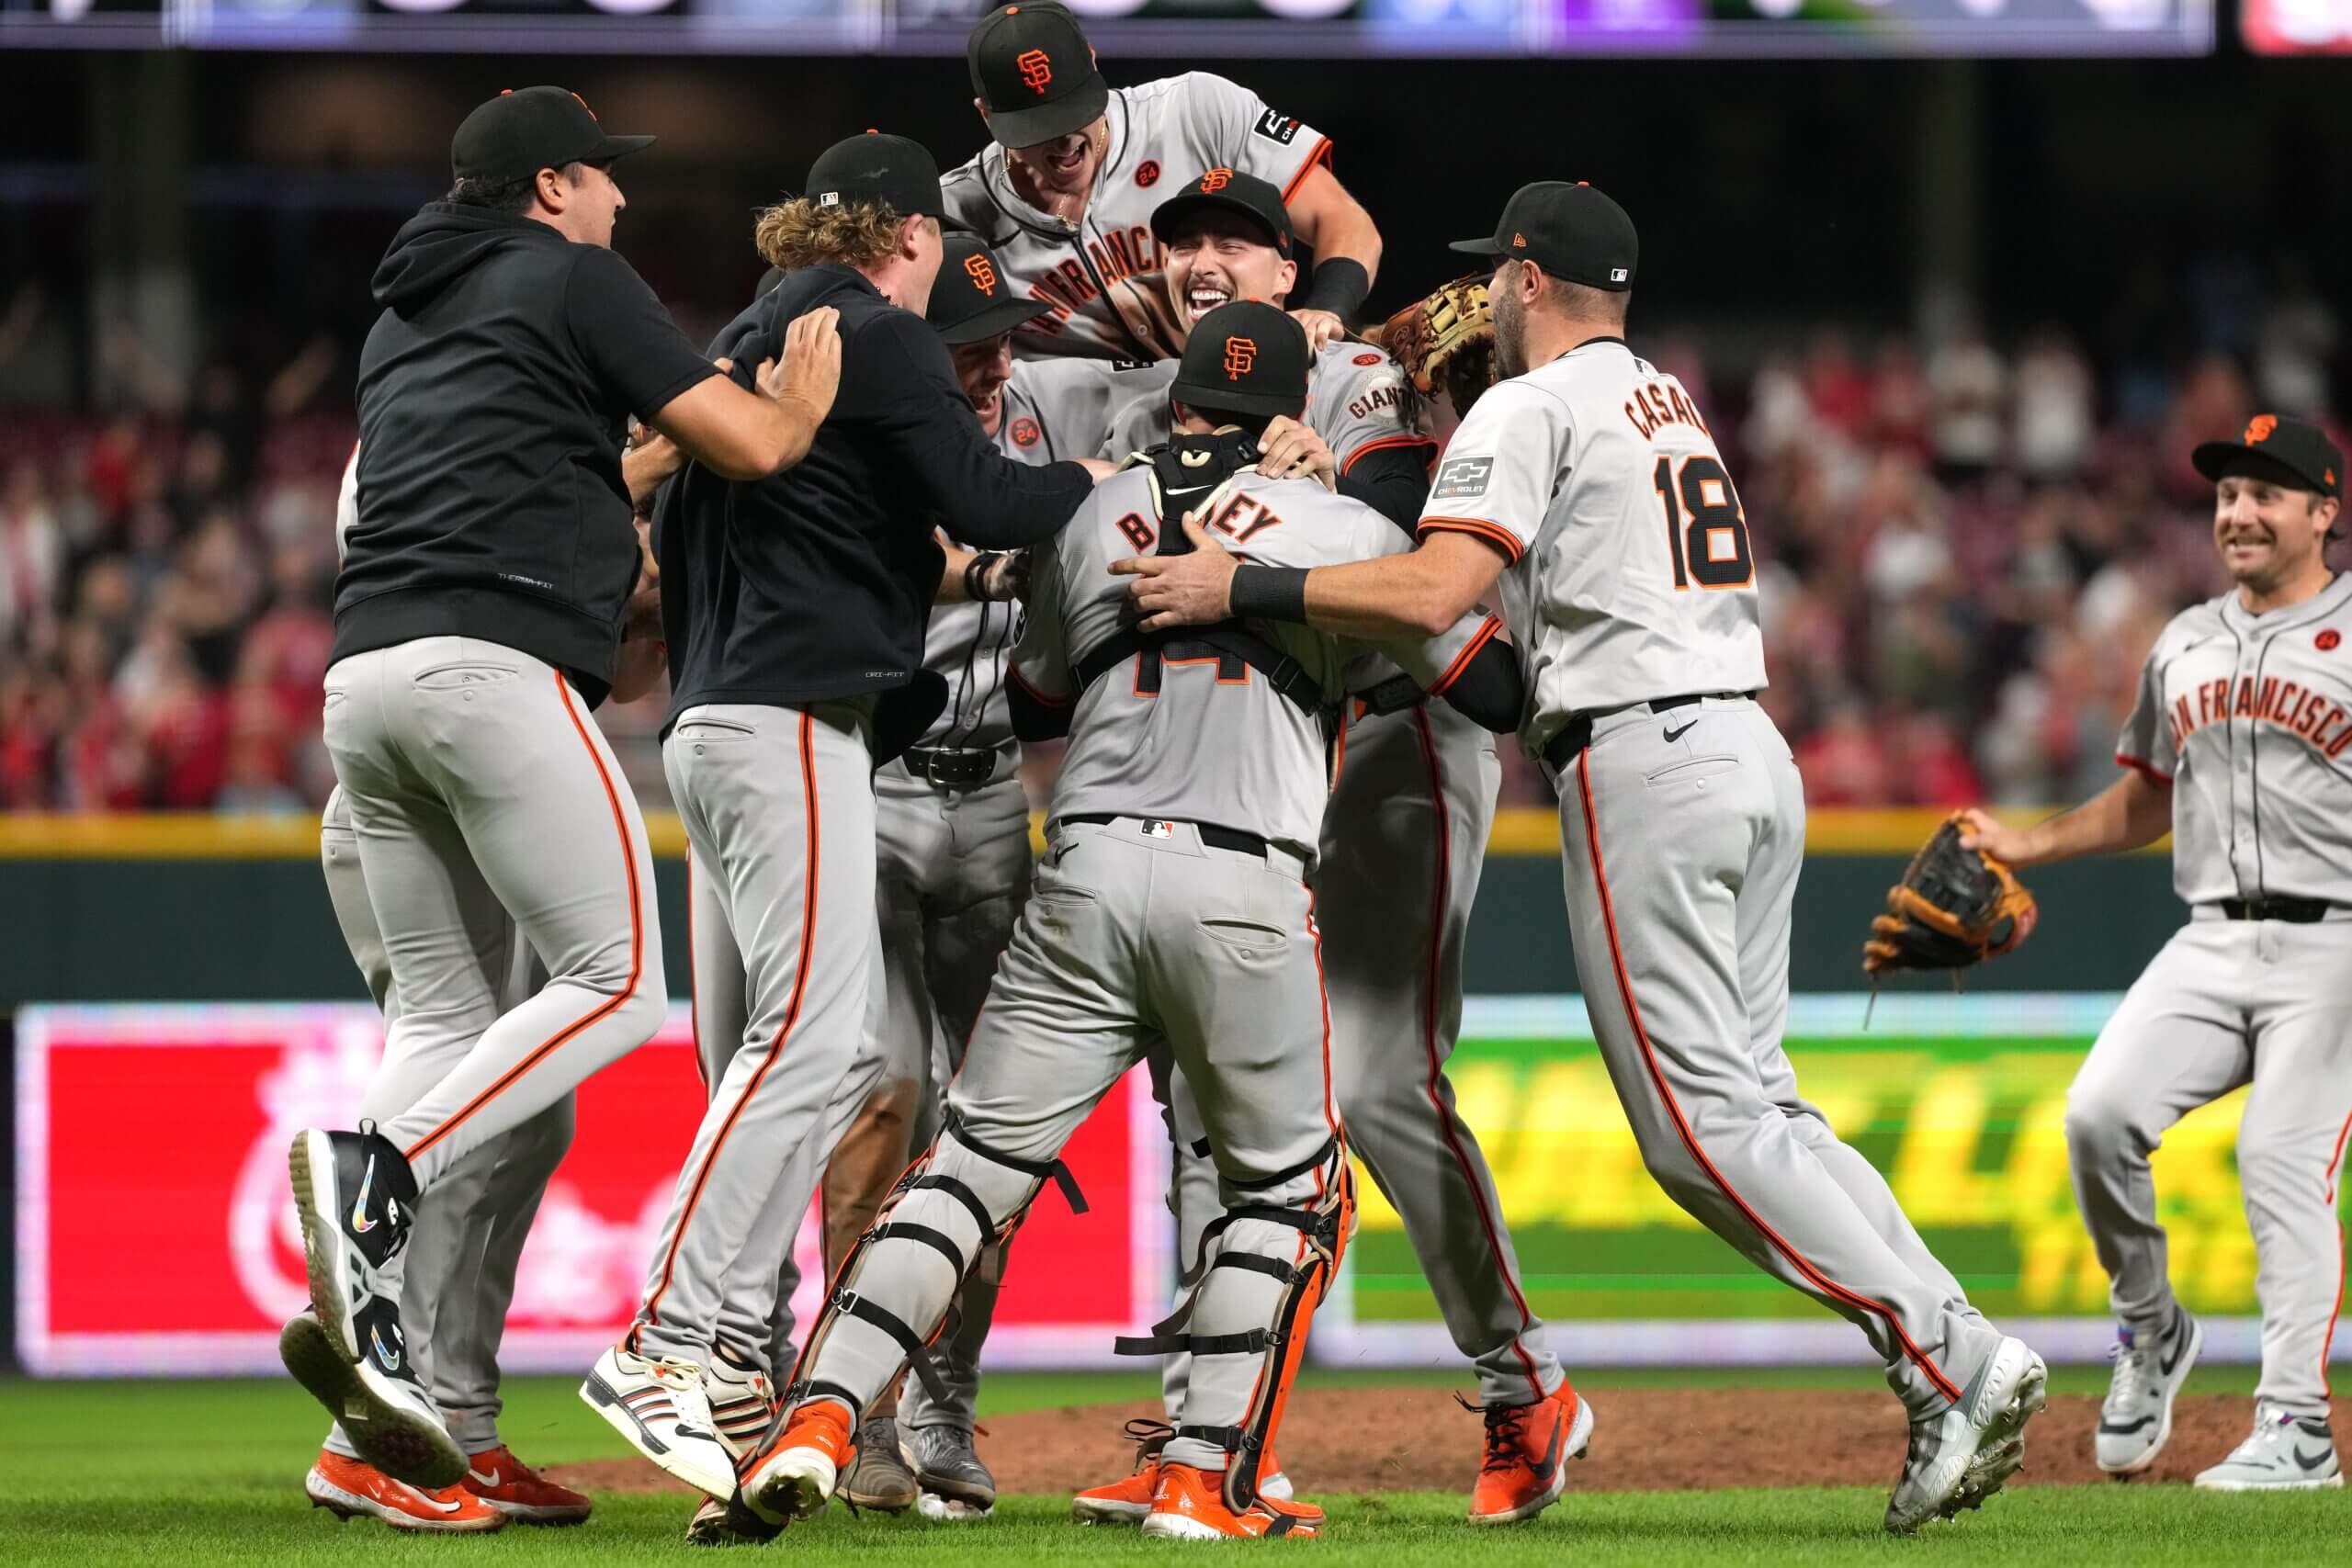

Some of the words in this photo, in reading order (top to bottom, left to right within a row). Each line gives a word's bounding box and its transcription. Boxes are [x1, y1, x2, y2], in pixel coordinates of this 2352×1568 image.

[1016, 49, 1052, 95] SF
[1200, 167, 1234, 195] SF
[964, 253, 996, 296] SF
[1044, 224, 1168, 308] FRANCI
[1224, 335, 1257, 381] SF
[1623, 381, 1710, 442] CASAL
[1654, 456, 1756, 589] 18
